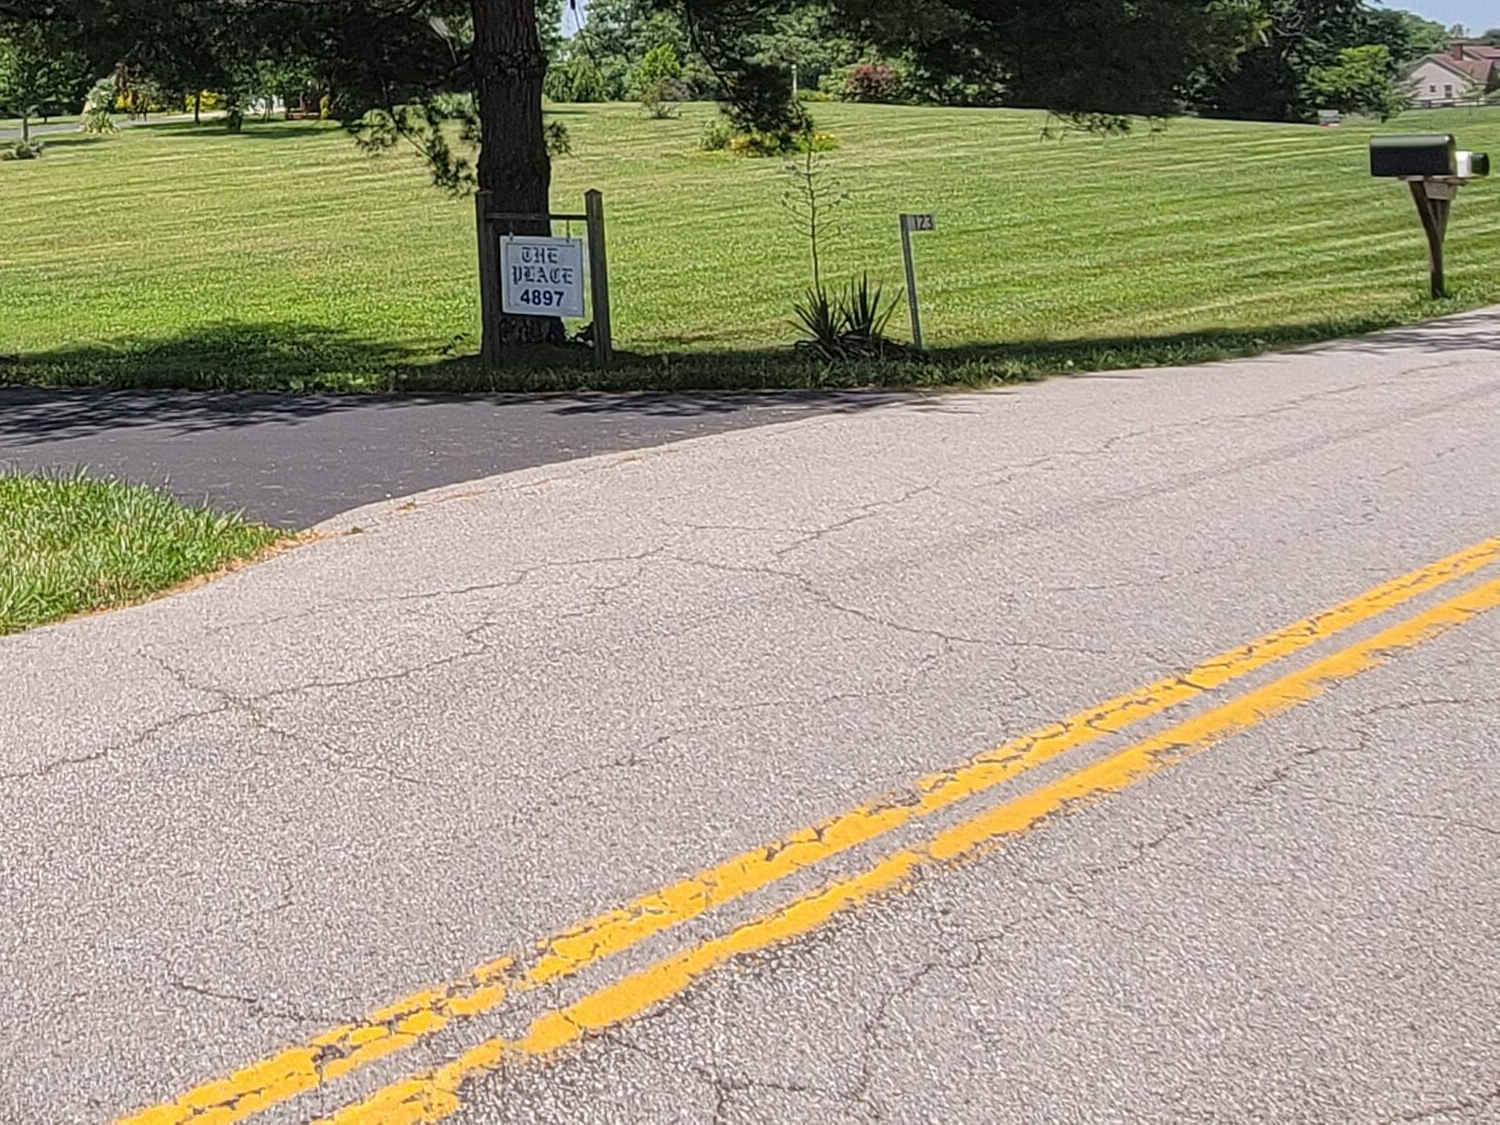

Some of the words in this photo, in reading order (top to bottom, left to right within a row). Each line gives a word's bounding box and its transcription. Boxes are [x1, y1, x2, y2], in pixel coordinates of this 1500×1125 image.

[521, 246, 559, 264] THE
[512, 265, 573, 286] PLACE
[520, 289, 565, 307] 4897
